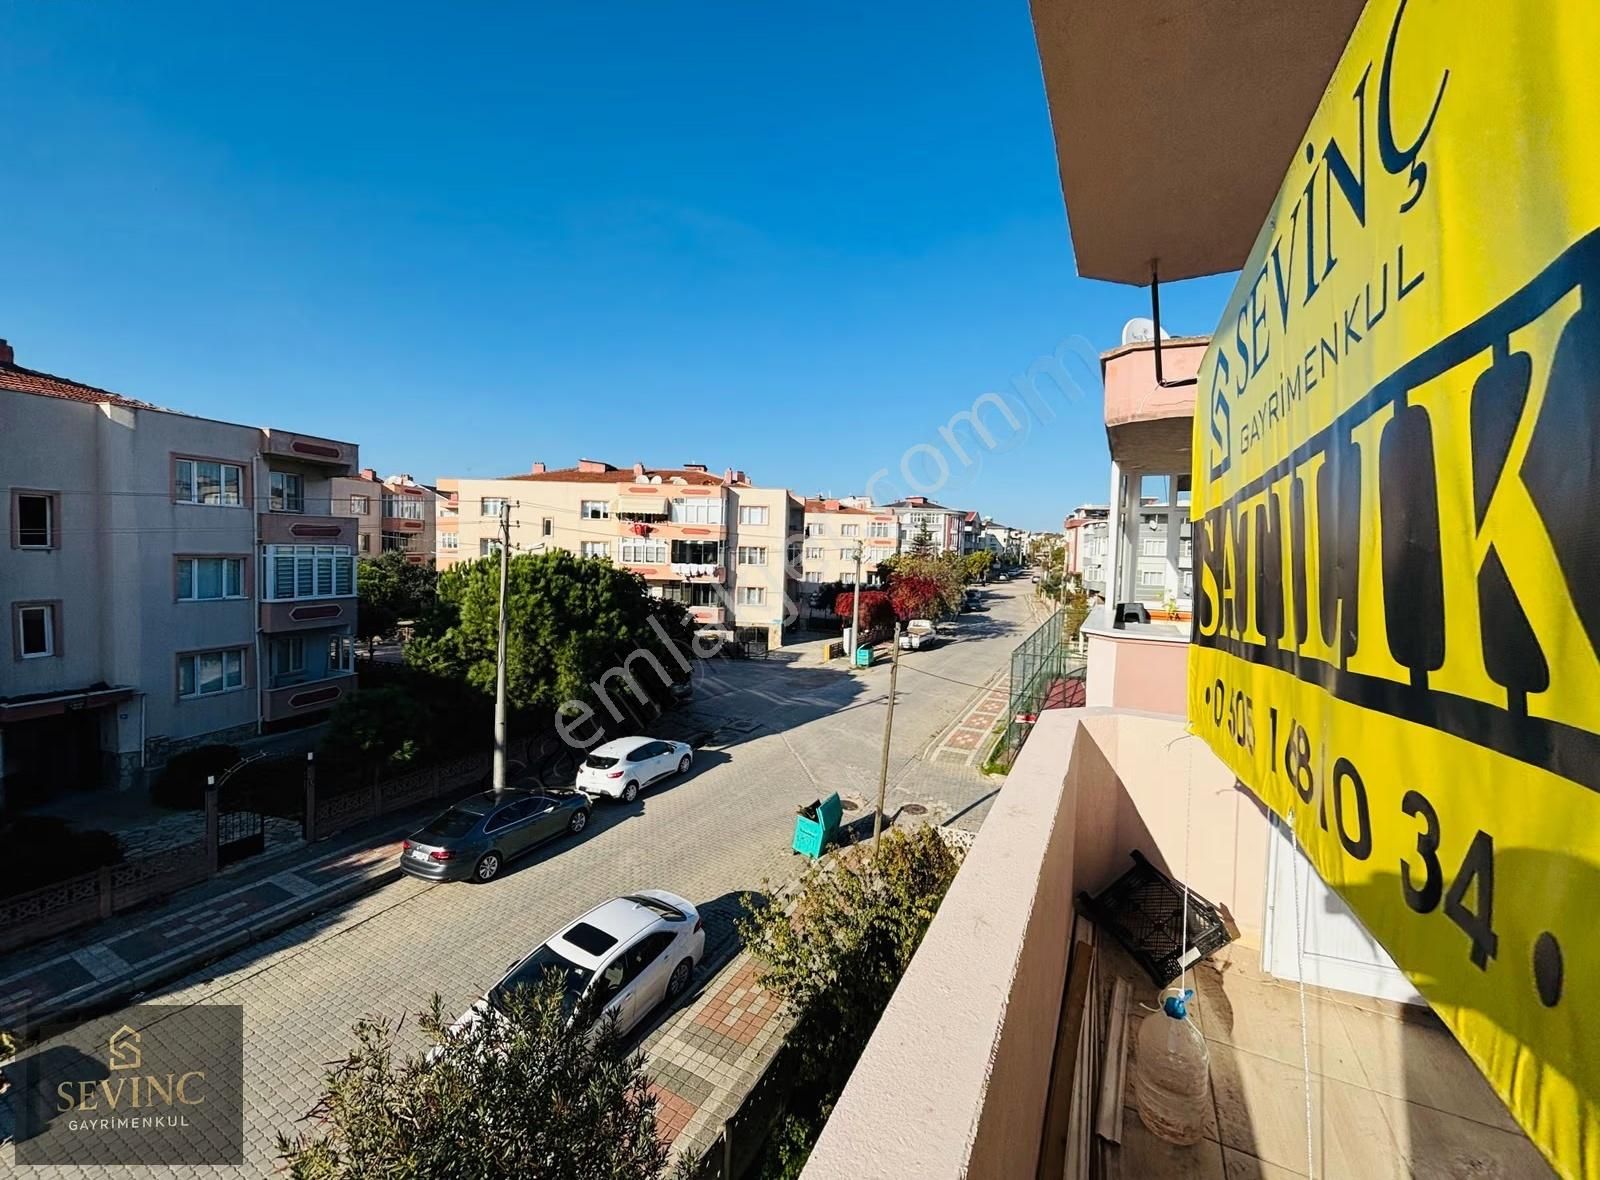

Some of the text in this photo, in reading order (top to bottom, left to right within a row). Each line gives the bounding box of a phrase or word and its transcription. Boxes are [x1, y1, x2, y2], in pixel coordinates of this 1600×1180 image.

[1236, 0, 1450, 398] SEVİNÇ
[1239, 244, 1425, 455] GAYRİMENKUL
[1199, 284, 1600, 738] SATILIK
